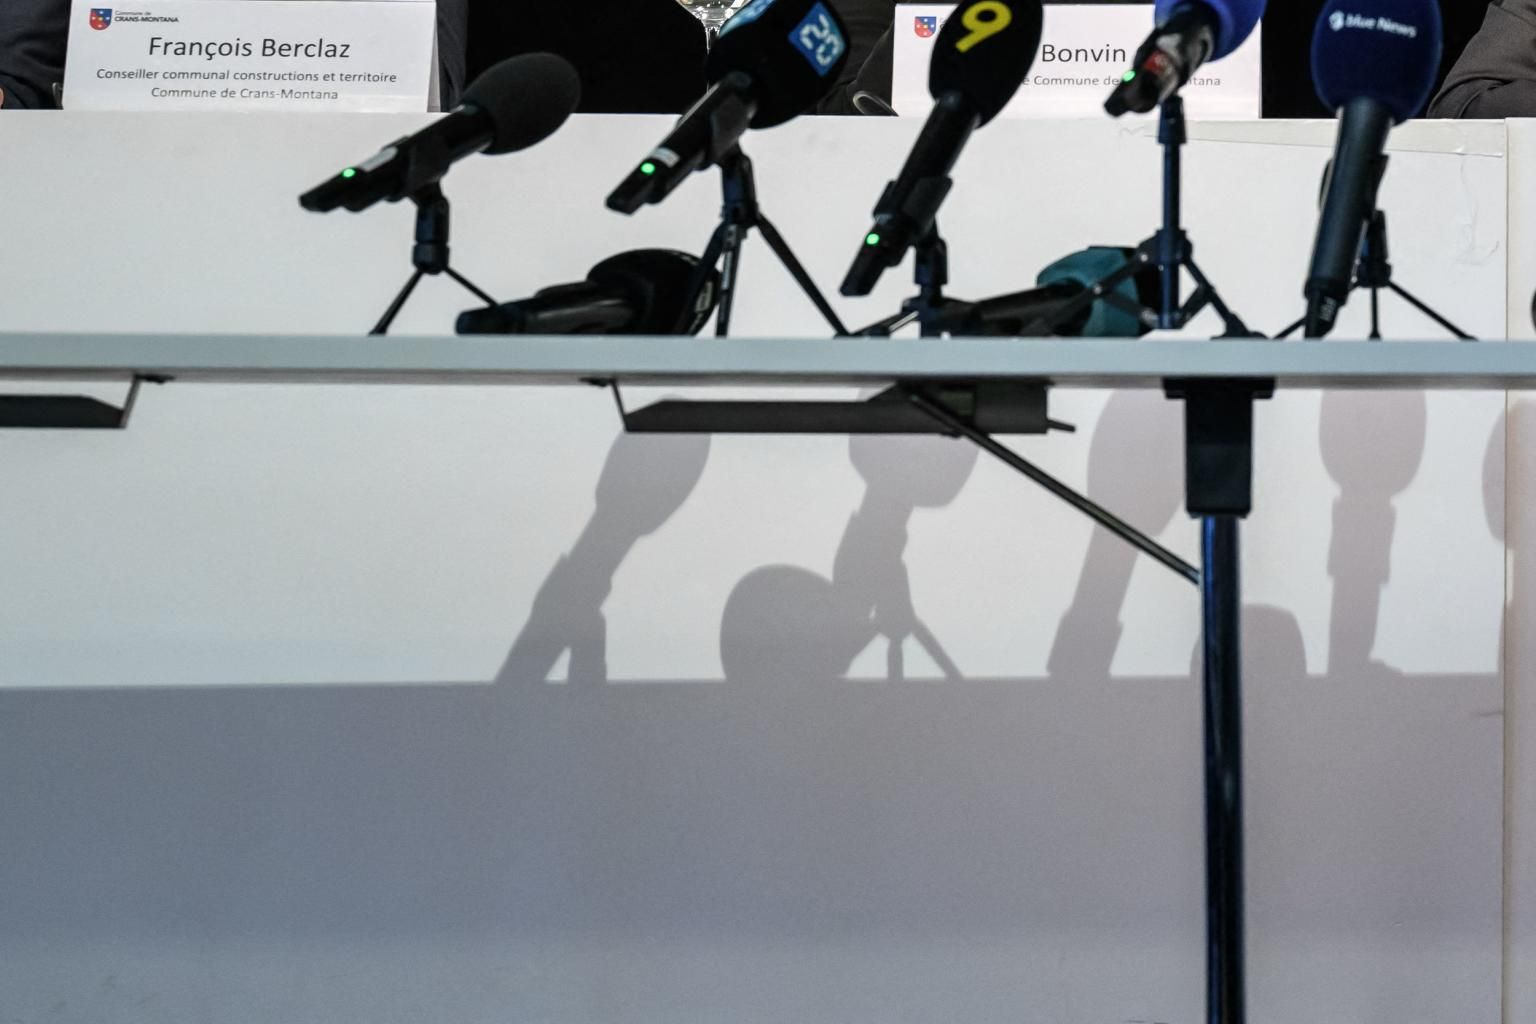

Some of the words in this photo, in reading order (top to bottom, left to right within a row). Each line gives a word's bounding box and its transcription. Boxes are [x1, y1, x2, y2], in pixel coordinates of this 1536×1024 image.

[955, 0, 1012, 53] 9
[1377, 16, 1417, 38] News
[148, 37, 253, 61] François
[262, 38, 351, 59] Berclaz
[1042, 43, 1126, 63] Bonvin
[96, 68, 159, 80] Conseiller
[162, 69, 230, 81] communal
[233, 69, 319, 82] constructions
[322, 71, 336, 82] et
[339, 71, 397, 83] territoire
[1034, 75, 1099, 86] Commune
[1103, 75, 1119, 86] de
[151, 87, 217, 99] Commune
[221, 87, 237, 99] de
[239, 88, 339, 100] Crans-Montana
